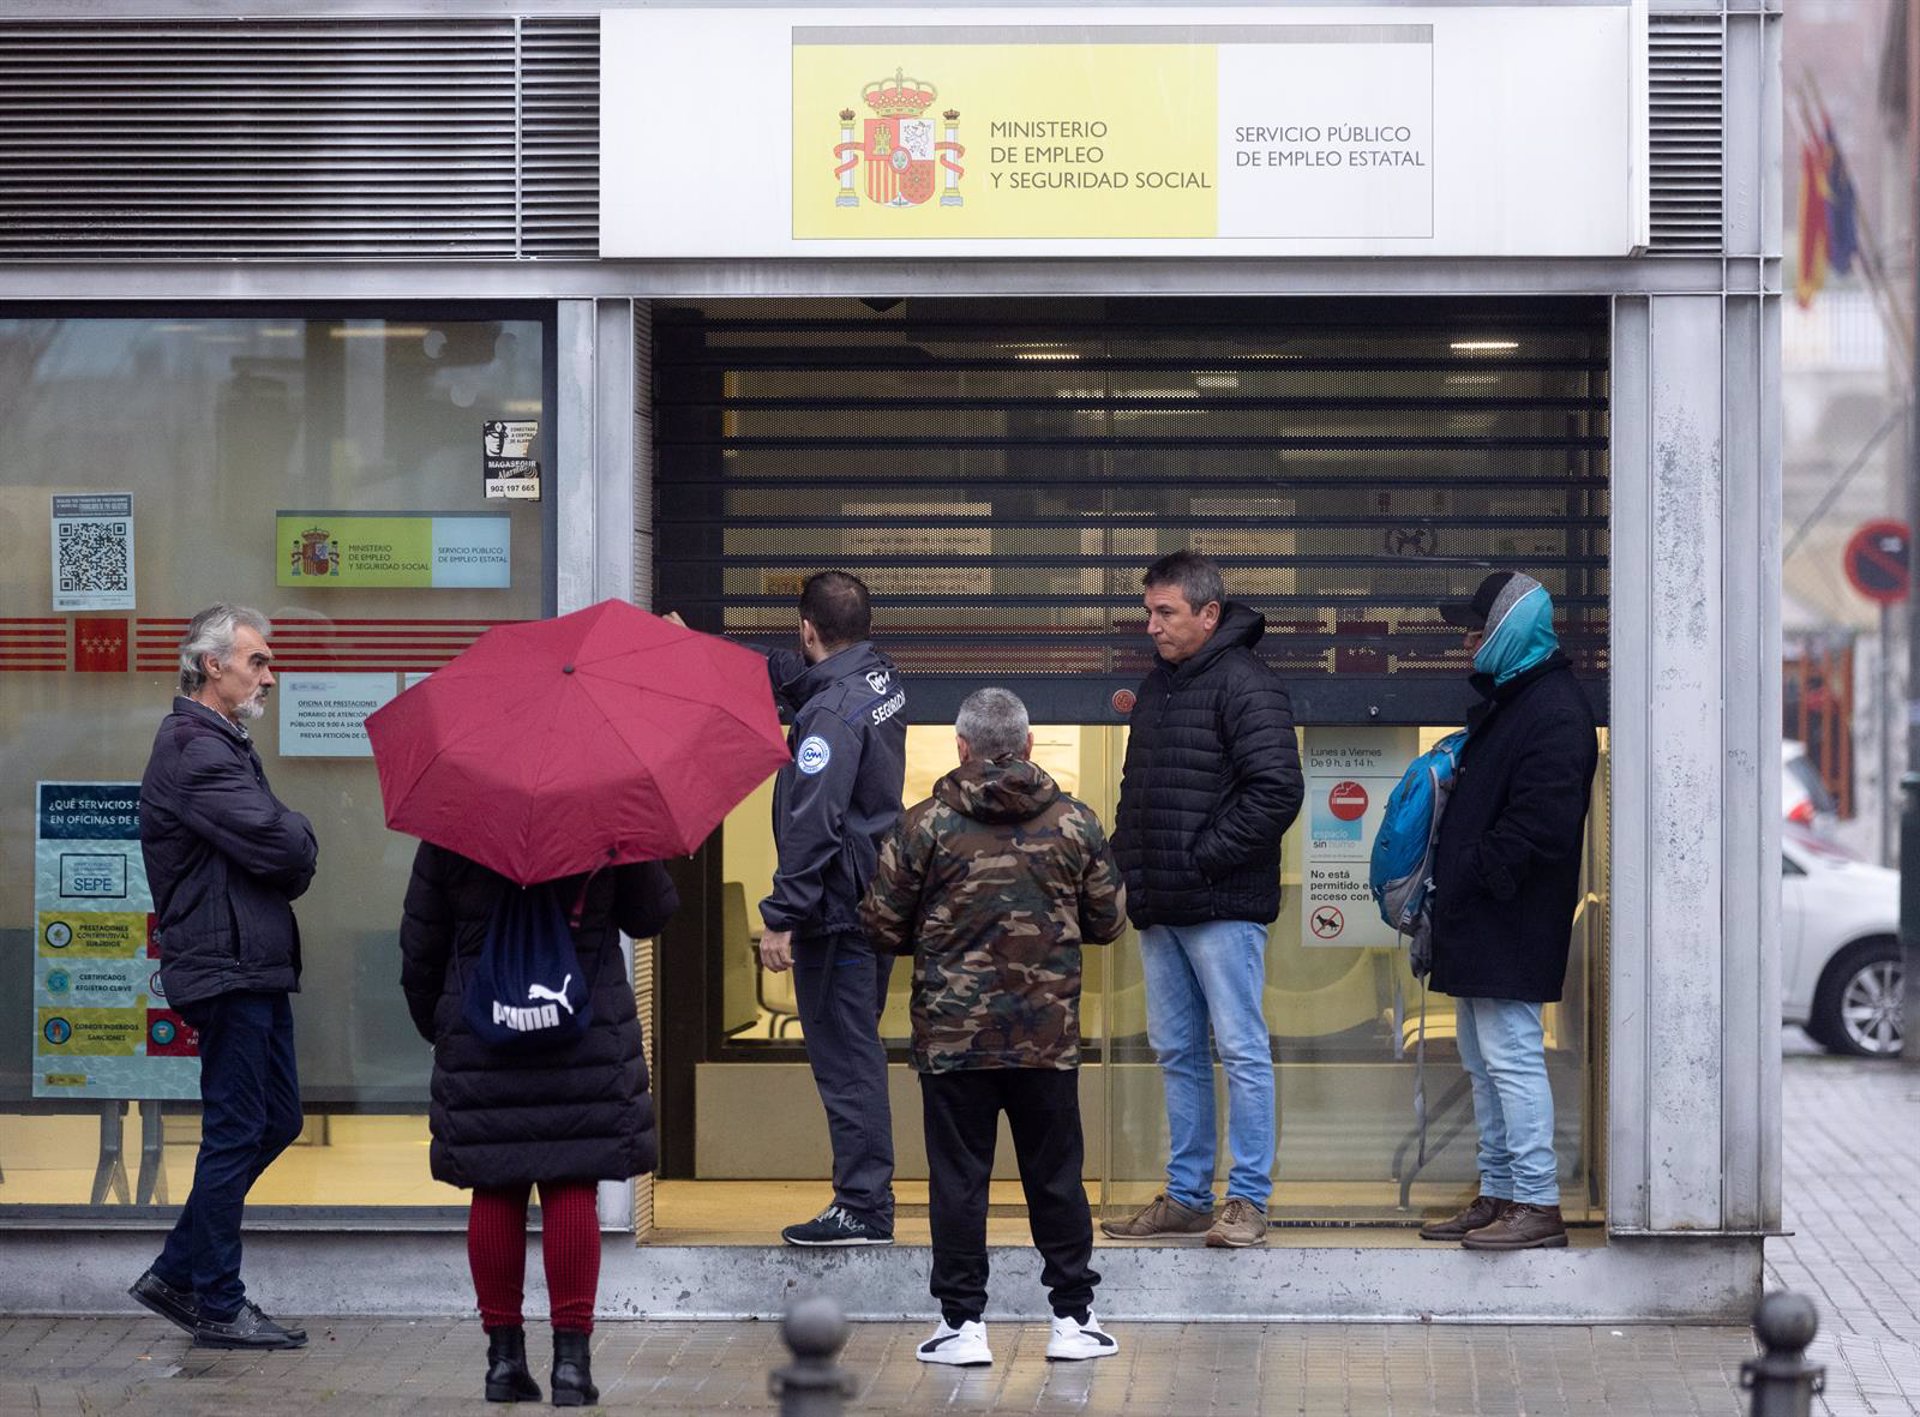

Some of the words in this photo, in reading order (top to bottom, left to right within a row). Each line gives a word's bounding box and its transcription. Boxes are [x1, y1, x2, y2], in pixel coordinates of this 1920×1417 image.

[990, 121, 1108, 138] MINISTERIO
[1235, 126, 1321, 143] SERVICIO
[1327, 122, 1411, 143] PÚBLICO
[990, 146, 1018, 163] DE
[1024, 146, 1104, 163] EMPLEO
[1236, 151, 1262, 167] DE
[1268, 151, 1342, 167] EMPLEO
[1349, 151, 1425, 167] ESTATAL
[990, 172, 1003, 189] Y
[1009, 172, 1129, 189] SEGURIDAD
[1135, 172, 1212, 189] SOCIAL
[521, 484, 536, 492] 665
[348, 544, 393, 553] MINISTERIO
[438, 546, 470, 554] SERVICIO
[471, 546, 504, 554] PÚBLICO
[348, 553, 359, 561] DE
[360, 553, 391, 561] EMPLEO
[355, 563, 400, 571] SEGURIDAD
[401, 563, 429, 571] SOCIAL
[333, 700, 378, 708] PRESTACIONES
[1310, 747, 1338, 757] Lunes
[1340, 749, 1346, 757] a
[1348, 747, 1382, 757] Viernes
[1310, 758, 1324, 768] De
[1326, 758, 1332, 768] 9
[1334, 758, 1342, 768] h.
[1354, 758, 1364, 768] 14
[79, 800, 133, 810] SERVICIOS
[50, 815, 64, 824] EN
[66, 815, 116, 825] OFICINAS
[118, 815, 131, 825] DE
[1313, 839, 1327, 849] sin
[1310, 869, 1326, 879] No
[1328, 869, 1351, 879] está
[73, 877, 113, 892] SEPE
[1310, 880, 1360, 891] permitido
[1310, 892, 1348, 901] acceso
[1350, 892, 1370, 901] con
[492, 1000, 560, 1032] PUMA
